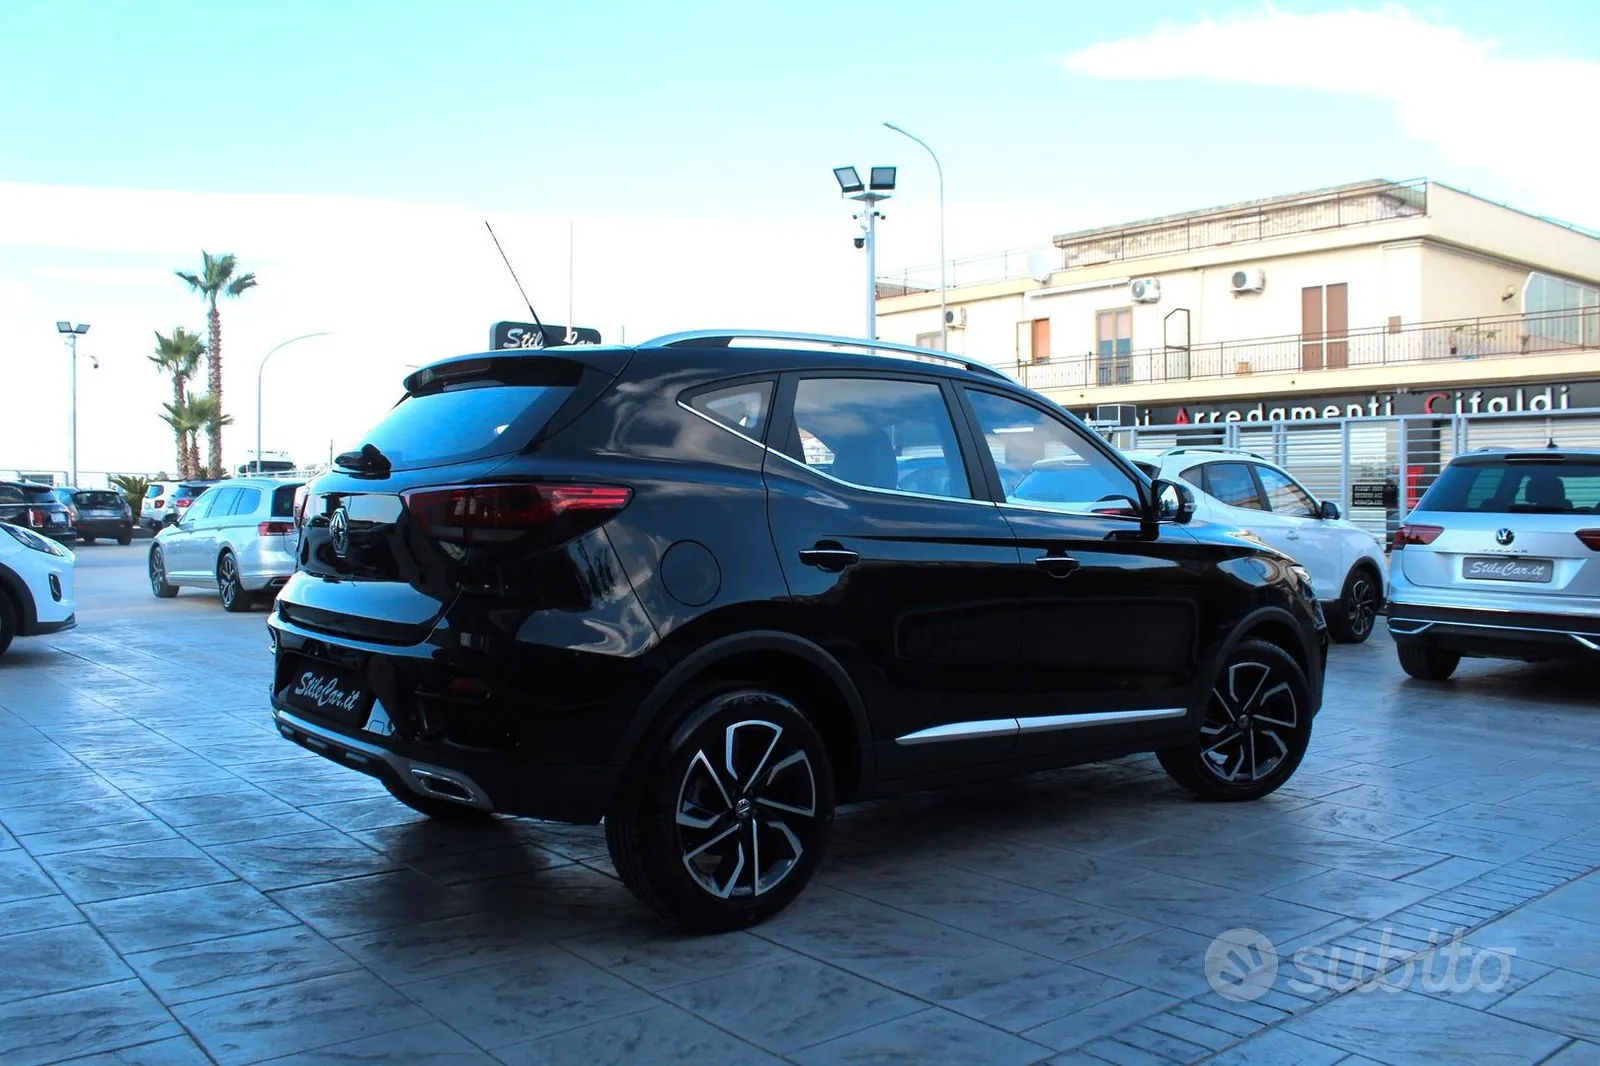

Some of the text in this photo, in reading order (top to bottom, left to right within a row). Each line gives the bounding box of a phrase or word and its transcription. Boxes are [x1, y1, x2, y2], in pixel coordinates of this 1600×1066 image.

[1176, 395, 1394, 424] Arredamenti
[1424, 386, 1568, 417] Cifaldi
[1469, 561, 1544, 576] StileCar.it
[294, 671, 361, 711] StileCar.it
